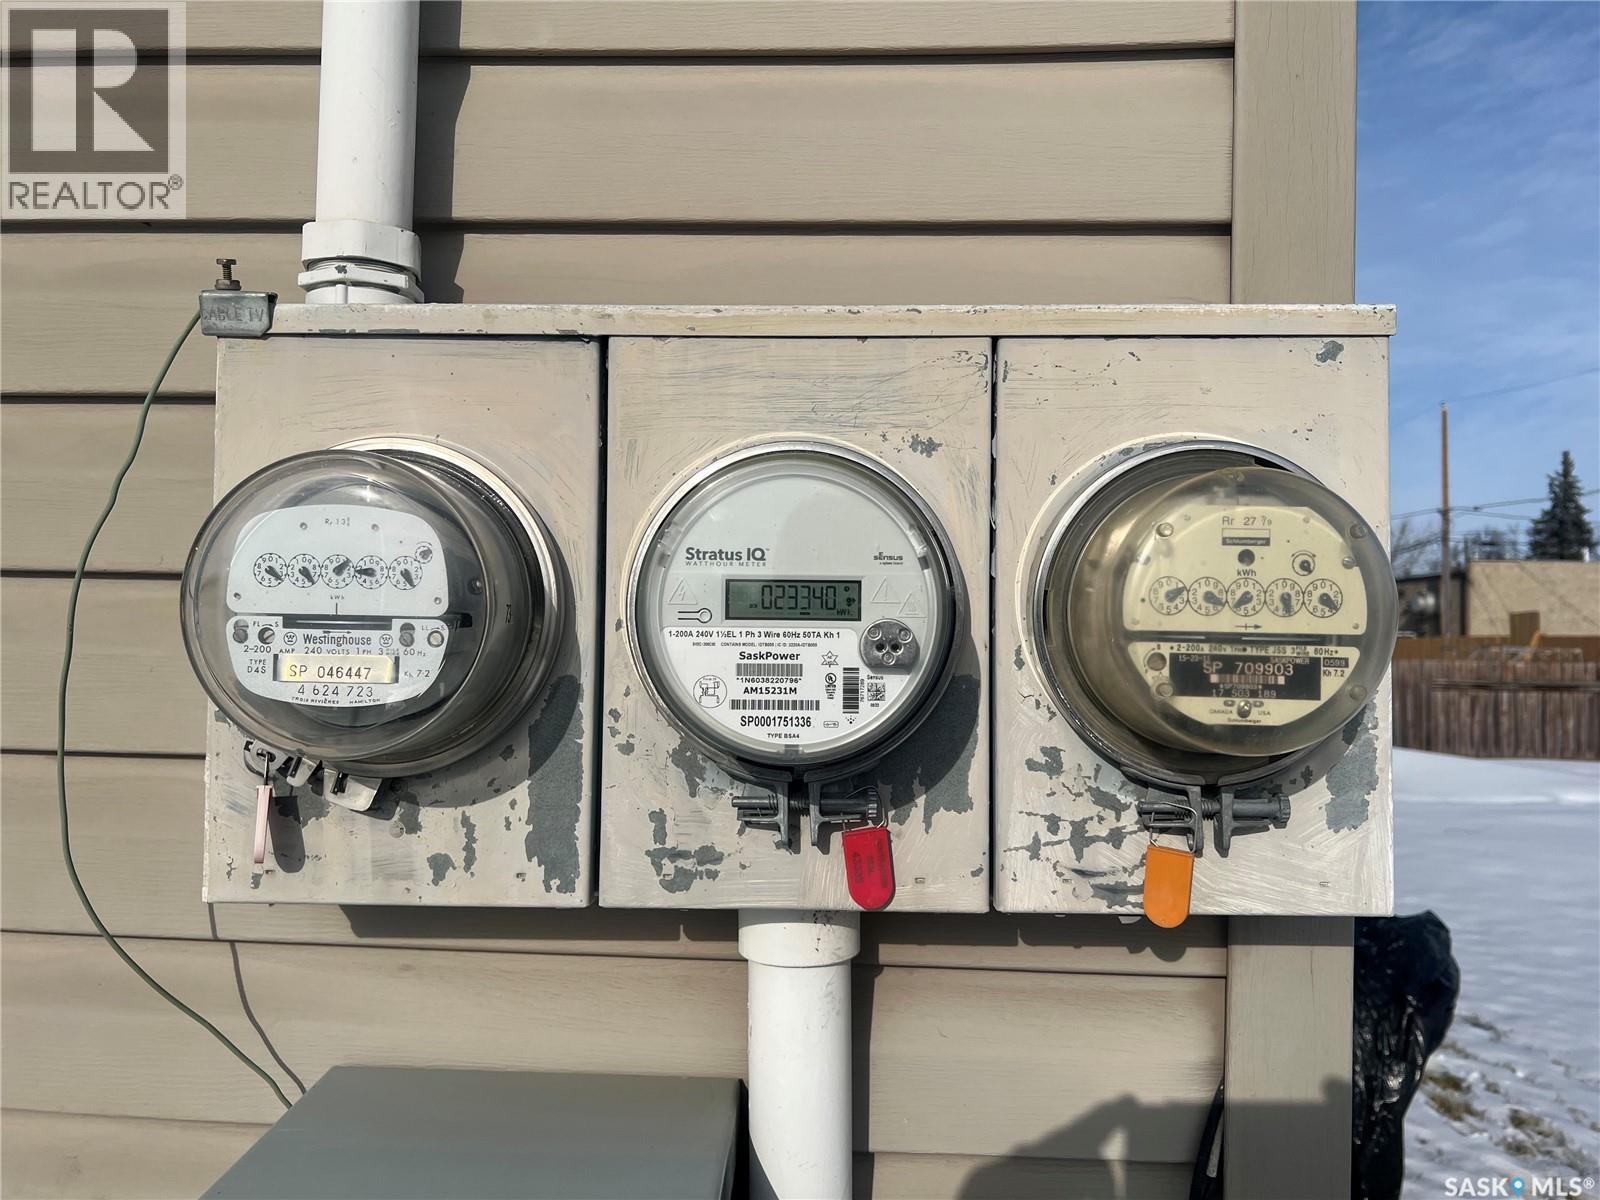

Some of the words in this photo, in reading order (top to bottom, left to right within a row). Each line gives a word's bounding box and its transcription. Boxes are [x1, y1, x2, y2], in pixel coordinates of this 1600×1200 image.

[248, 307, 264, 322] TV
[1243, 516, 1256, 526] 27
[685, 547, 743, 560] Stratus
[762, 585, 836, 610] 023340
[303, 634, 372, 647] Westinghouse
[244, 645, 272, 653] 2-200
[1250, 646, 1269, 654] TYPE
[739, 652, 800, 660] SaskPower
[290, 664, 308, 677] SP
[318, 666, 371, 680] 046447
[1203, 661, 1223, 674] SP
[1235, 662, 1294, 676] 709903
[1323, 669, 1332, 677] Kh
[298, 684, 305, 695] 4
[312, 684, 339, 696] 624
[346, 686, 373, 698] 723
[740, 716, 812, 727] SP0001751336
